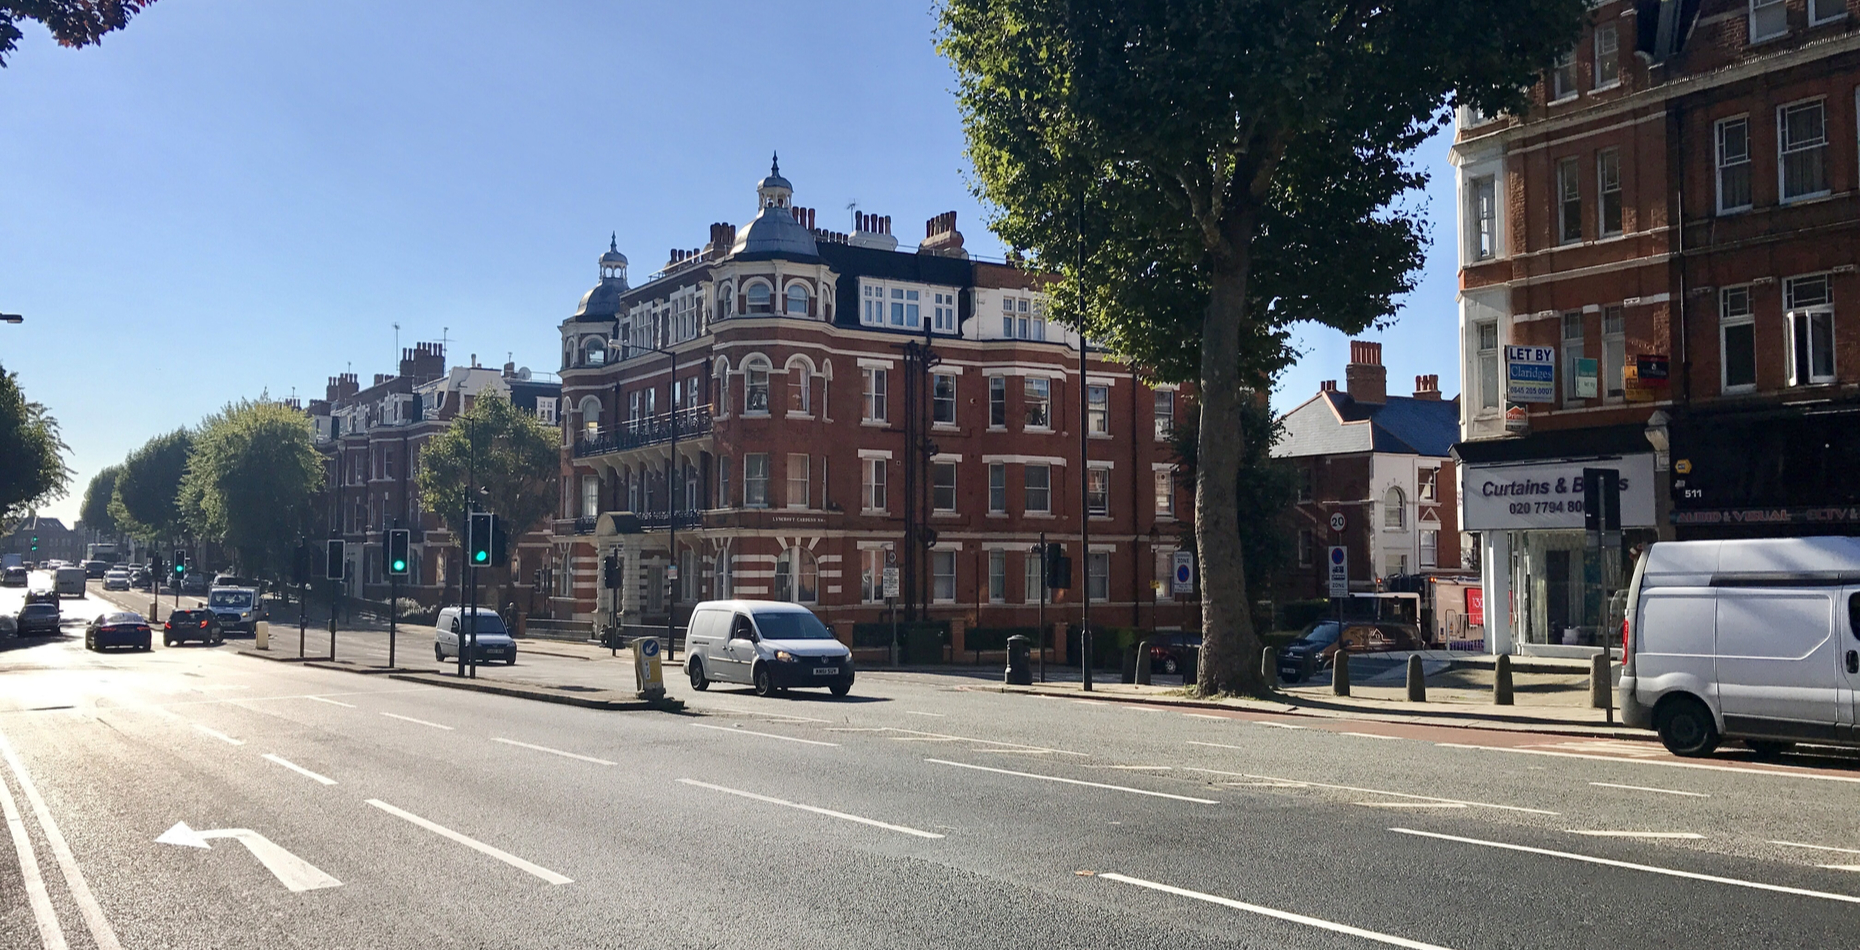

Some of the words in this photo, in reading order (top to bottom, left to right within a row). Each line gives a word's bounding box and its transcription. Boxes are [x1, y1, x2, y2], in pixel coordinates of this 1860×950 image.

[1509, 347, 1532, 361] LET
[1535, 349, 1552, 361] BY
[1511, 365, 1552, 380] Claridges
[1482, 479, 1550, 497] Curtains
[1554, 477, 1568, 494] &
[1684, 489, 1703, 498] 511
[1509, 502, 1531, 515] 020
[1534, 501, 1564, 514] 7794
[1331, 516, 1345, 527] 20
[1676, 512, 1721, 523] AUDIO
[1723, 511, 1732, 523] &
[1732, 509, 1792, 523] VISUAL
[1806, 508, 1848, 521] CCTV
